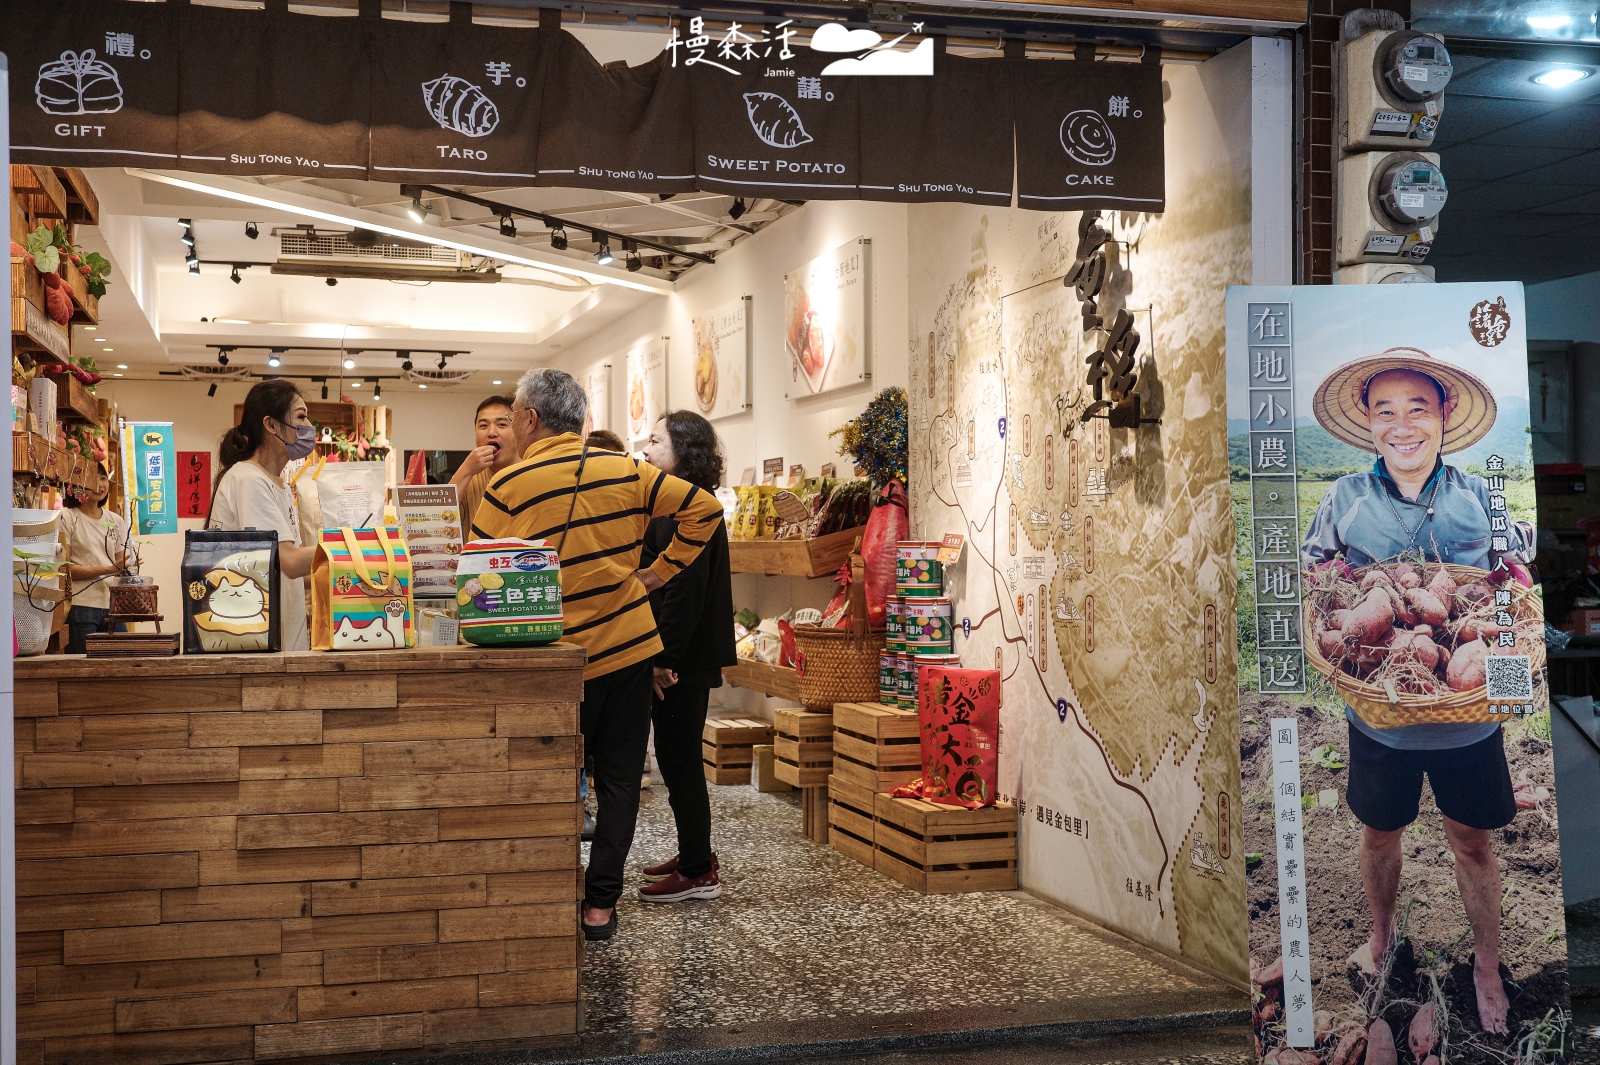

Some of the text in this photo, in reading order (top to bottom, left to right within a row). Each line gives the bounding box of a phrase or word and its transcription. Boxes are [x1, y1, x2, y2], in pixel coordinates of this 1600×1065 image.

[54, 123, 106, 137] GIFT
[436, 145, 488, 161] TARO
[230, 153, 320, 168] SHU TONG YAO
[707, 155, 846, 174] SWEET POTATO
[578, 166, 654, 180] SHU TONG YAO
[1065, 174, 1114, 186] CAKE
[898, 183, 974, 194] SHU TONG YAO
[1487, 455, 1517, 648] 金山地瓜職人 陳為民
[487, 606, 510, 614] SWEET
[512, 604, 538, 612] POTATO
[1487, 703, 1535, 715] 產地位置
